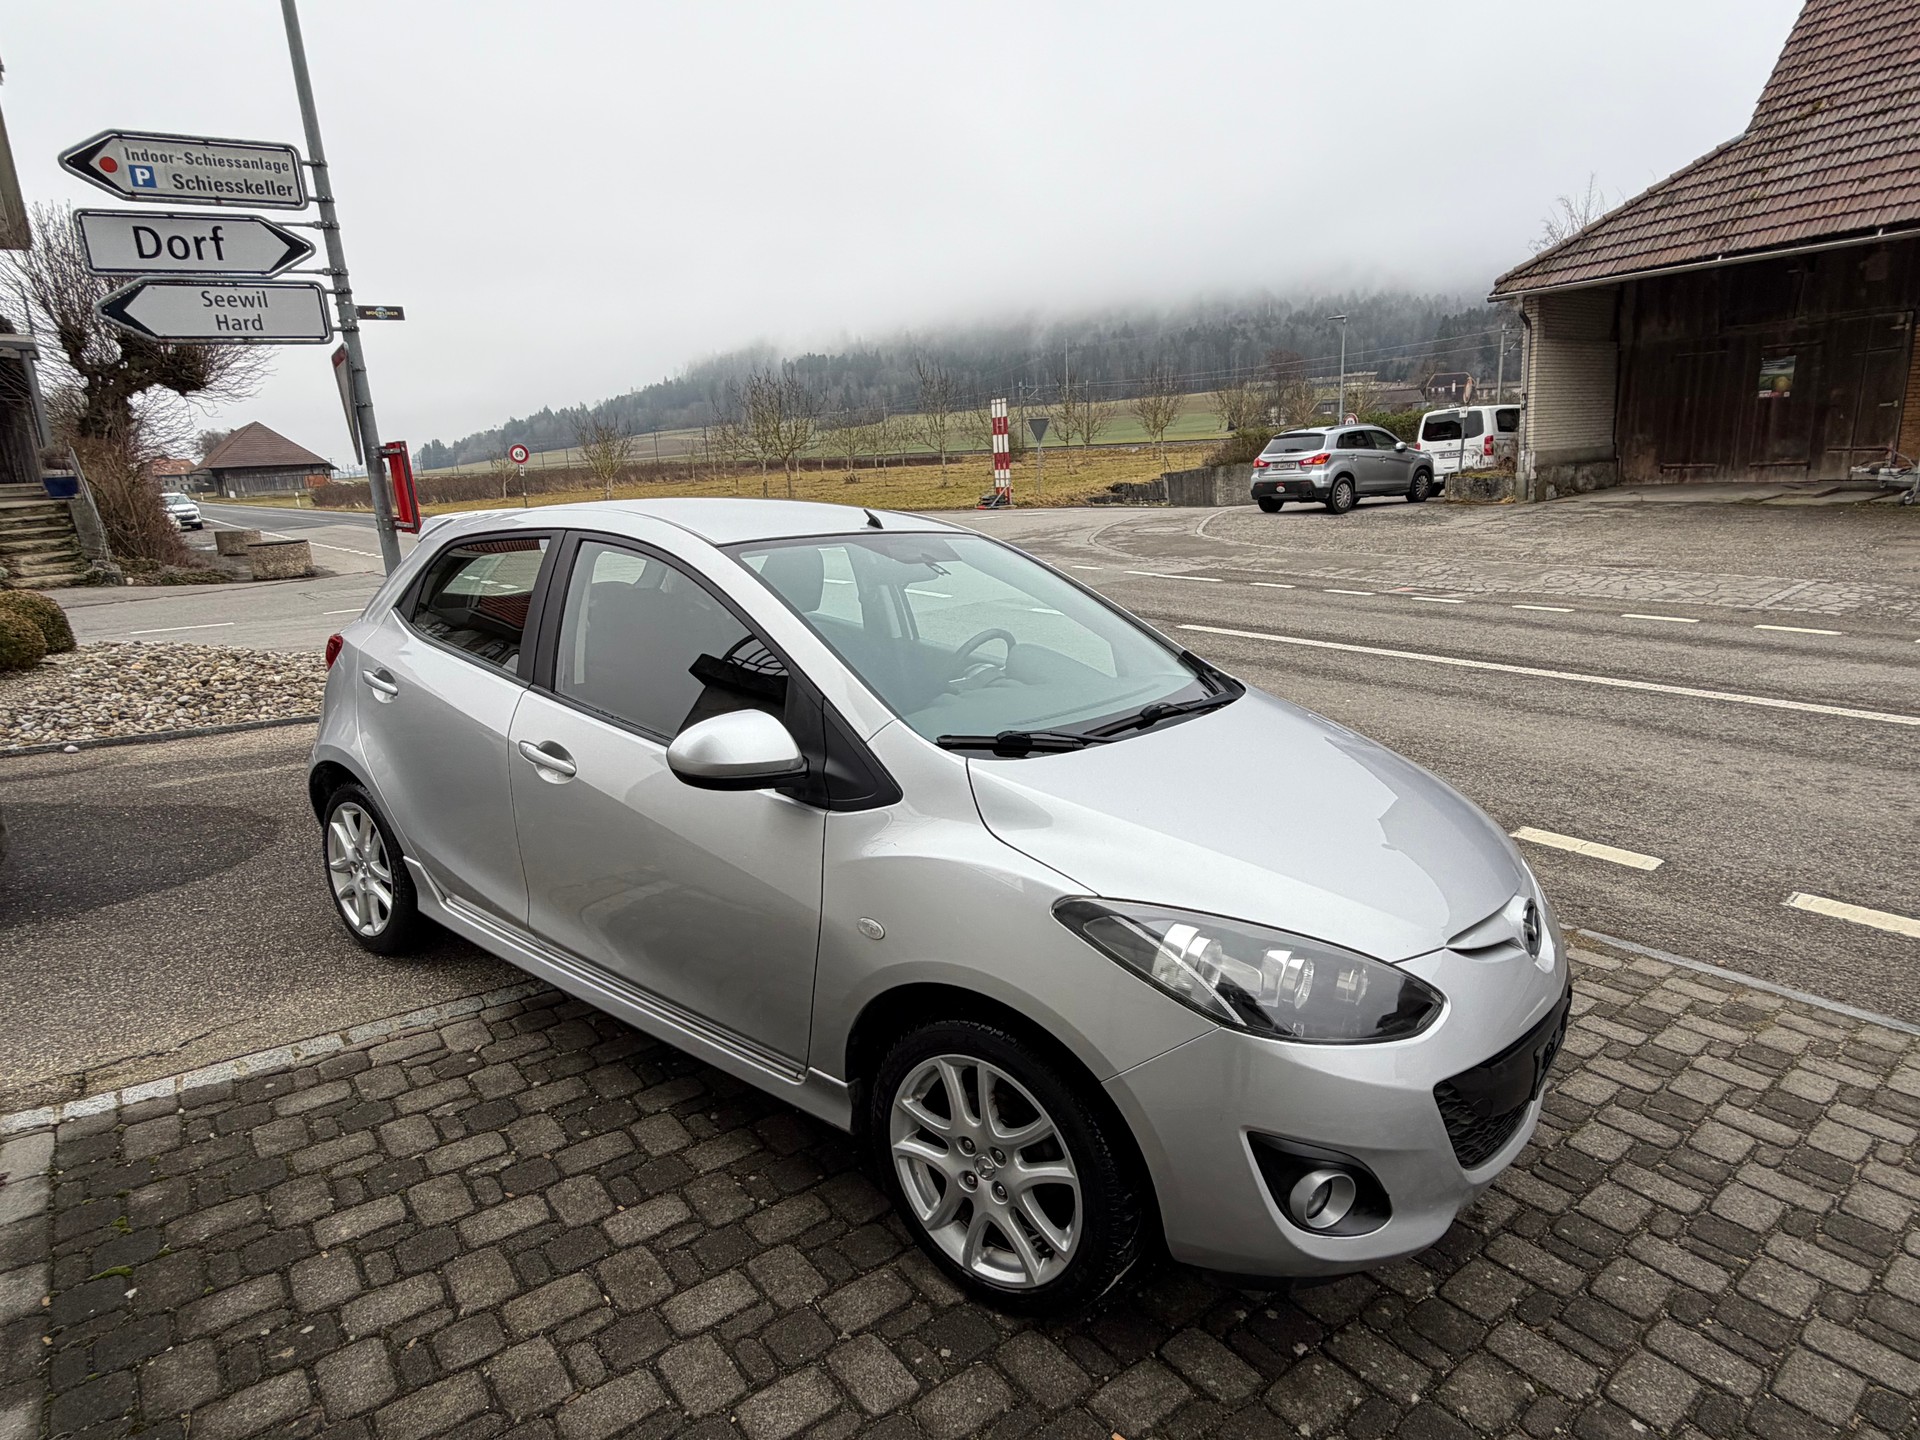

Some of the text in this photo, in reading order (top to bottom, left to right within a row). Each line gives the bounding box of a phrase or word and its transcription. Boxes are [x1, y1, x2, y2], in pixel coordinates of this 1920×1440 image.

[124, 146, 290, 173] Indoor-Schiessanlage
[135, 168, 150, 185] P
[172, 173, 294, 198] Schiesskeller
[132, 225, 224, 261] Dorf
[201, 290, 269, 309] Seewil
[216, 314, 264, 332] Hard
[515, 450, 523, 458] 60
